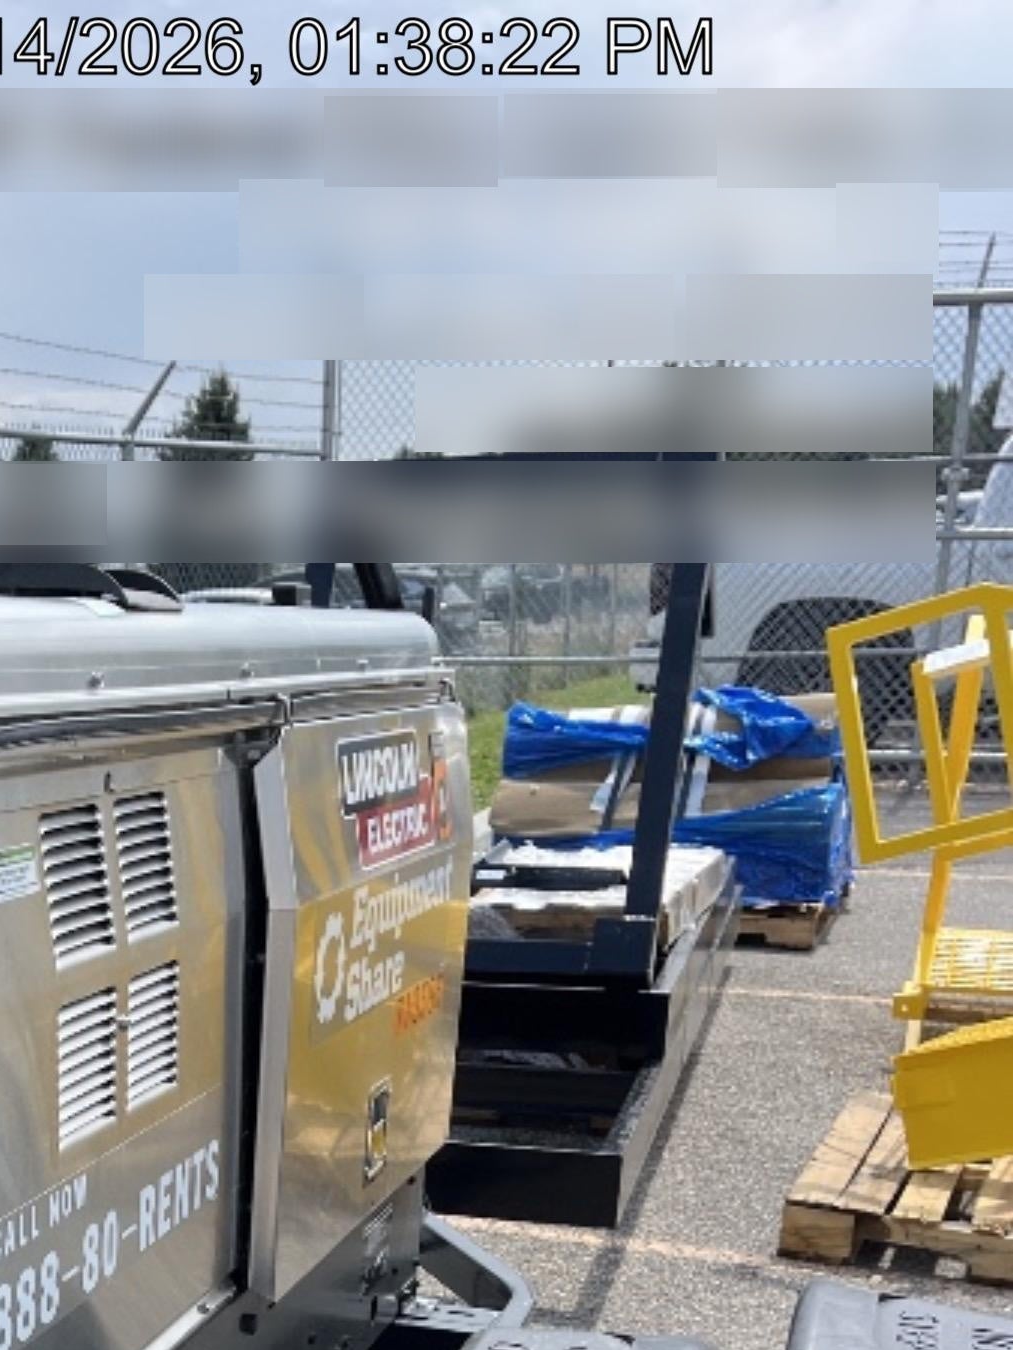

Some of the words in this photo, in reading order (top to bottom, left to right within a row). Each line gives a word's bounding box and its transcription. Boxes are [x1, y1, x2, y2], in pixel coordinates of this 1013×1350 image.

[341, 741, 418, 804] LINCOLN
[367, 803, 428, 856] ELECTRIC
[349, 854, 454, 953] Equipment
[344, 951, 405, 1023] Share
[49, 1172, 87, 1228] NOW
